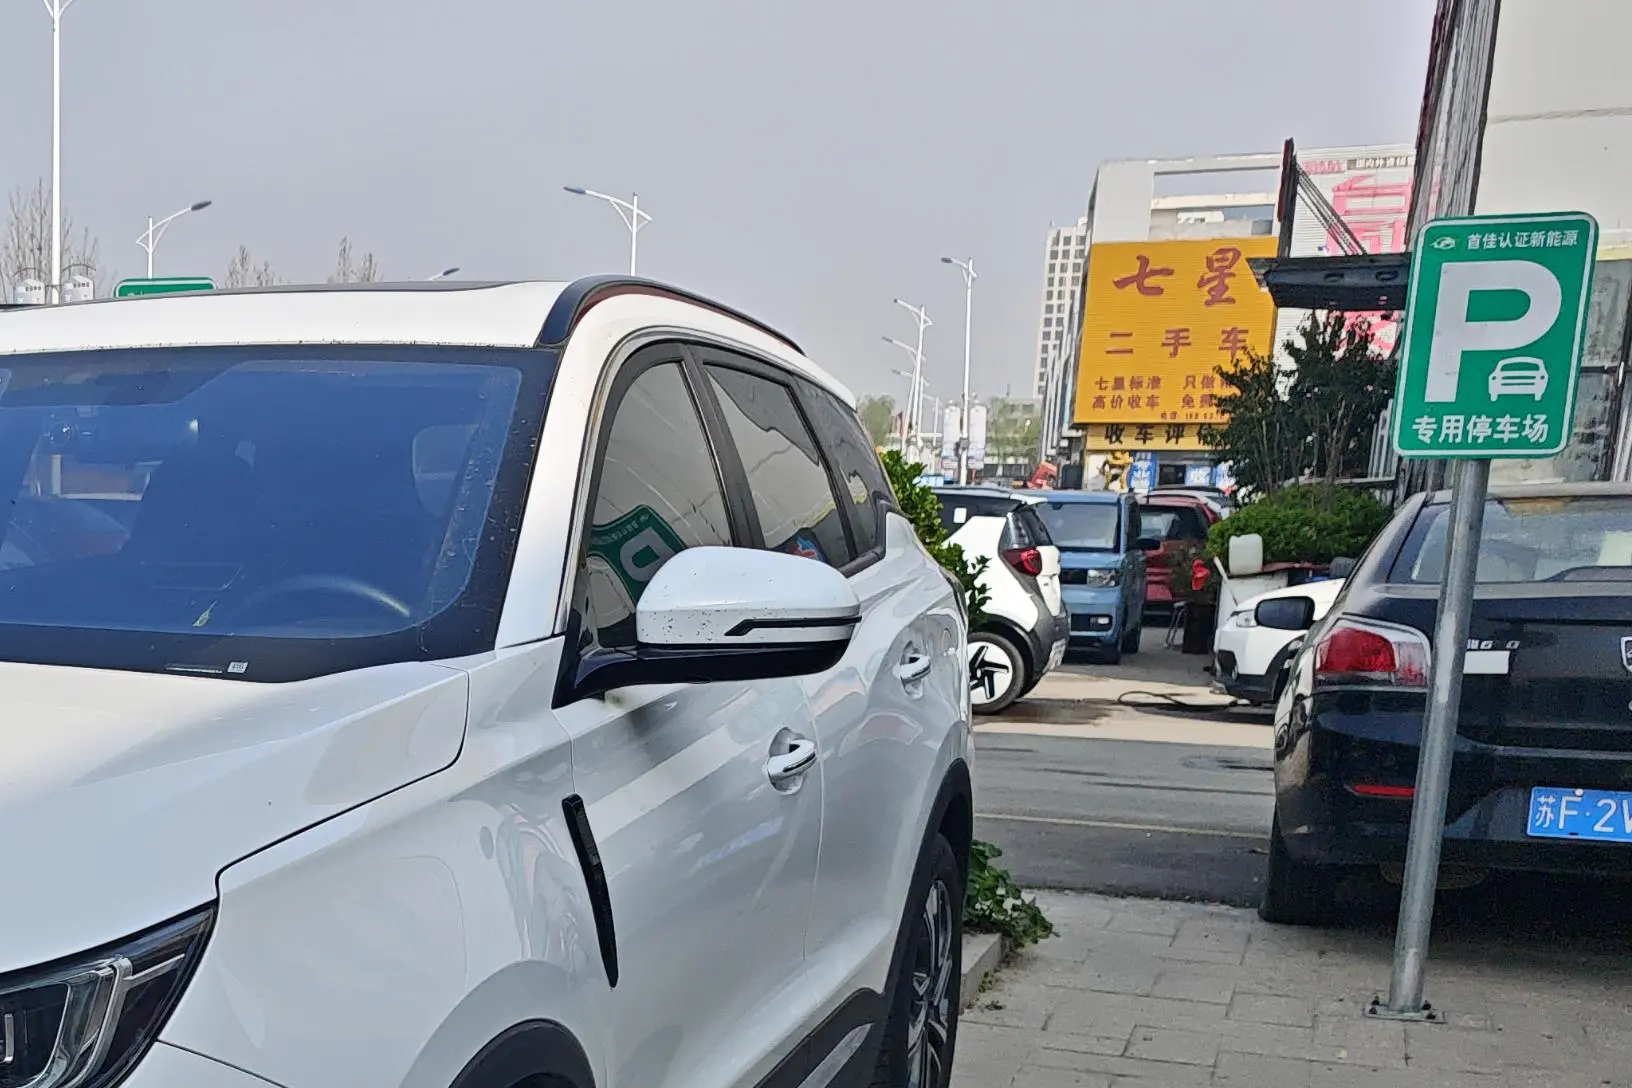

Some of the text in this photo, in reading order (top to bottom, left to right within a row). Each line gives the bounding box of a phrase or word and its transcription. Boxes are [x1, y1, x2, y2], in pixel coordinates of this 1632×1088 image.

[1468, 229, 1579, 250] 首佳认证新能源
[1112, 247, 1241, 308] 七星
[1105, 327, 1249, 364] 二手车
[1424, 260, 1562, 403] P
[1092, 394, 1160, 410] 高价收车
[1412, 414, 1550, 443] 专用停车场
